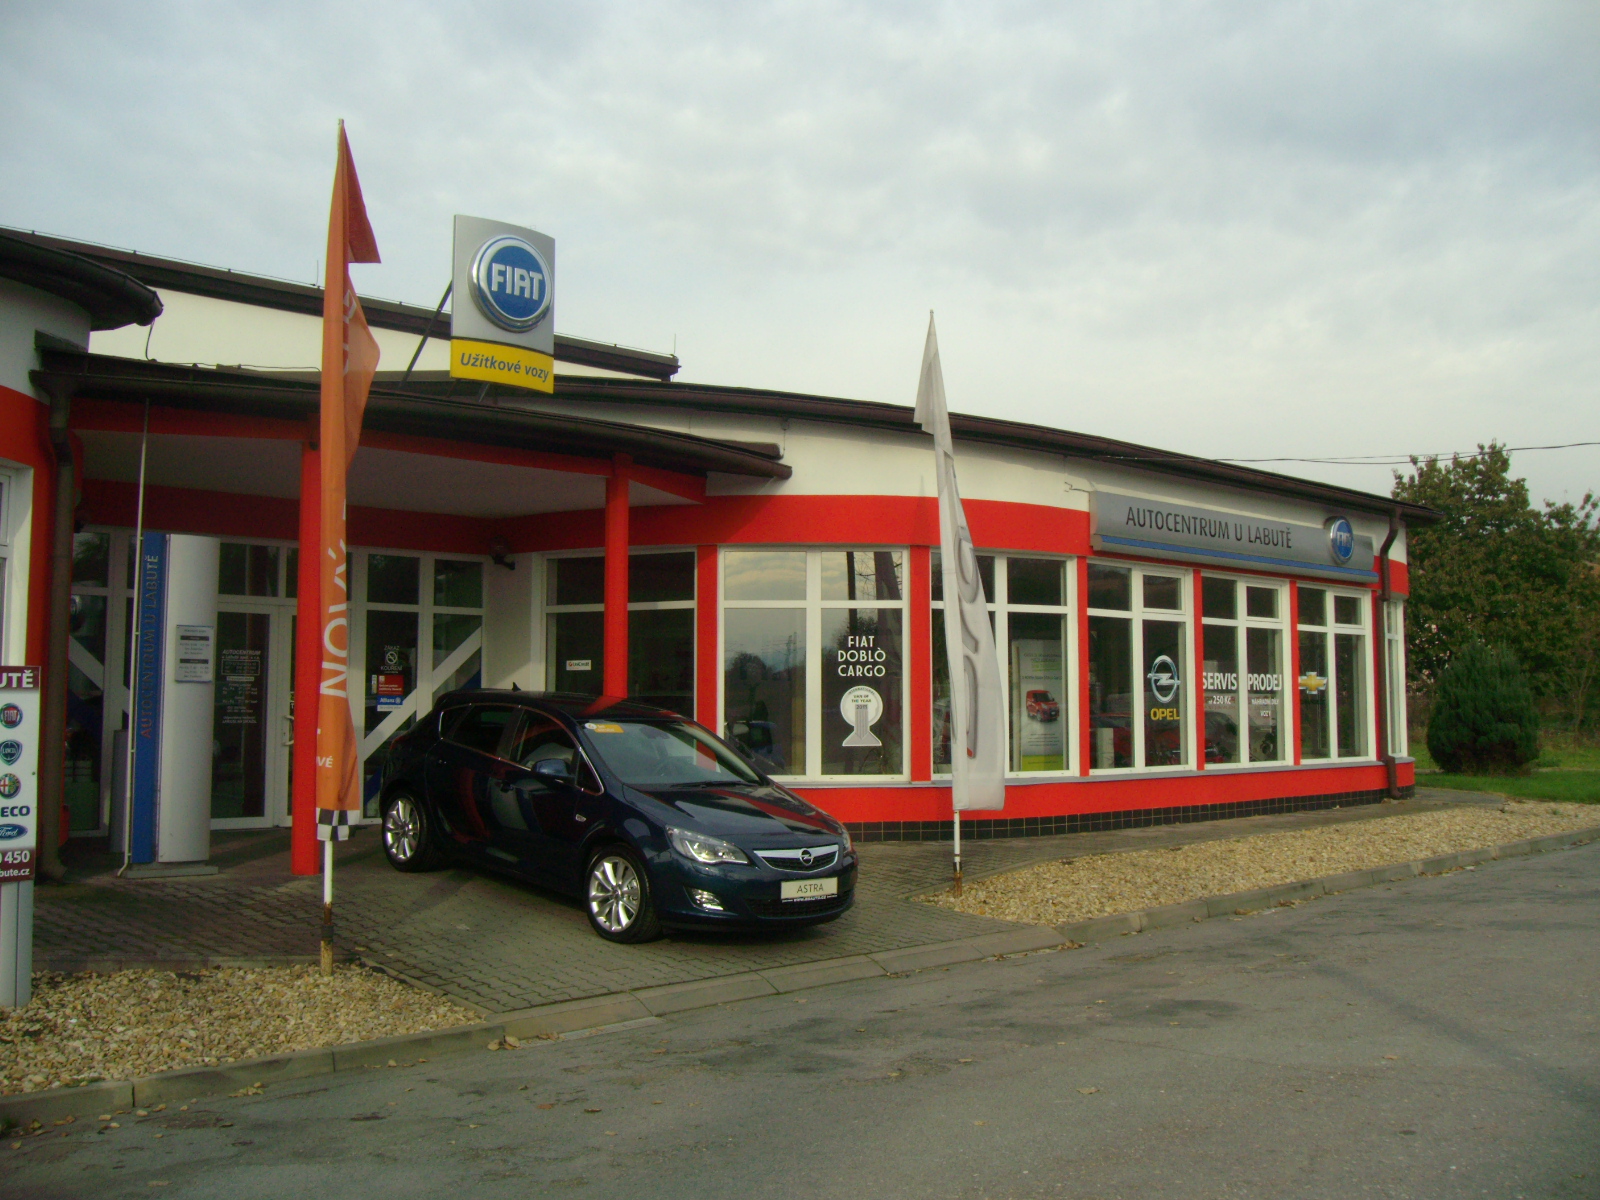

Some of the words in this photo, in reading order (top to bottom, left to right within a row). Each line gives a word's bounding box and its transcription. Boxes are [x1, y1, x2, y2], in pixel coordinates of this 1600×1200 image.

[491, 262, 543, 301] FIAT
[460, 352, 521, 374] Užitkové
[524, 365, 549, 383] vozy
[1125, 506, 1230, 540] AUTOCENTRUM
[1234, 523, 1243, 541] U
[1248, 525, 1292, 549] LABUTĚ
[144, 554, 159, 609] LABUTĚ
[848, 635, 875, 648] FIAT
[837, 647, 886, 662] DOBLÒ
[837, 664, 886, 677] CARGO
[1203, 672, 1238, 691] SERVIS
[1248, 673, 1283, 691] PRODEJ
[1213, 695, 1224, 705] 250
[1150, 708, 1180, 720] OPEL
[4, 850, 31, 864] 450
[796, 883, 824, 894] ASTRA
